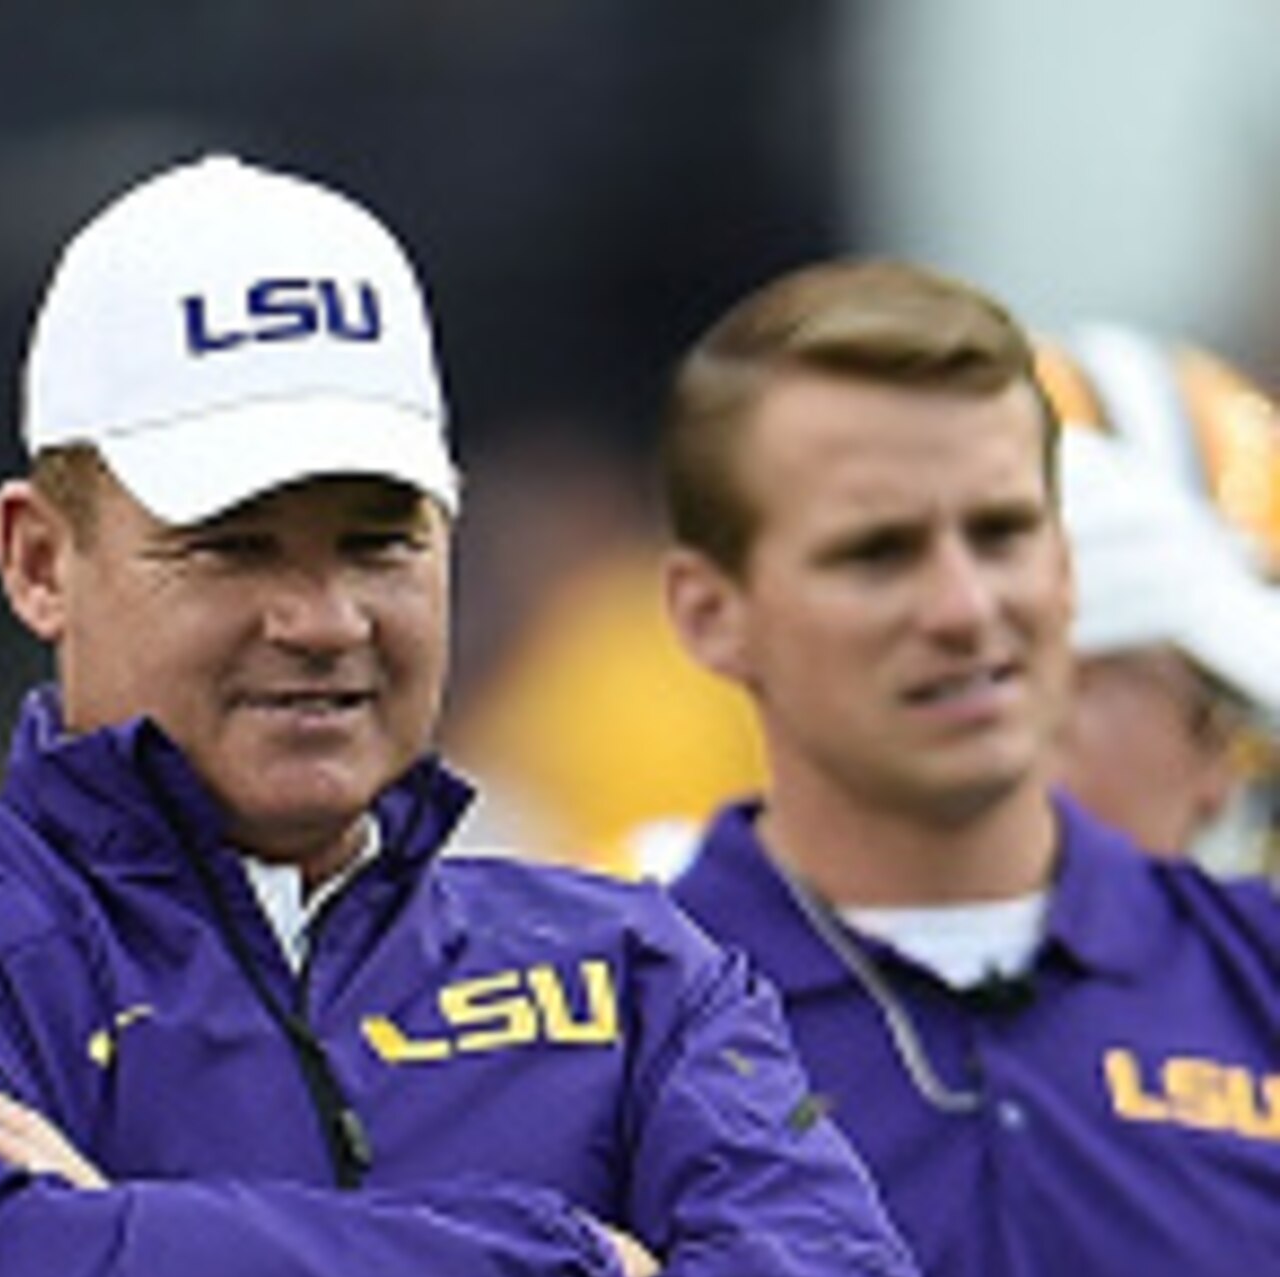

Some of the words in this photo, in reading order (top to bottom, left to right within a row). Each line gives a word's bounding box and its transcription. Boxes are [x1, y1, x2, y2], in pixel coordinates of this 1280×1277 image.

[181, 277, 381, 357] LSU
[361, 959, 617, 1063] LSU
[1104, 1048, 1280, 1140] LSU
